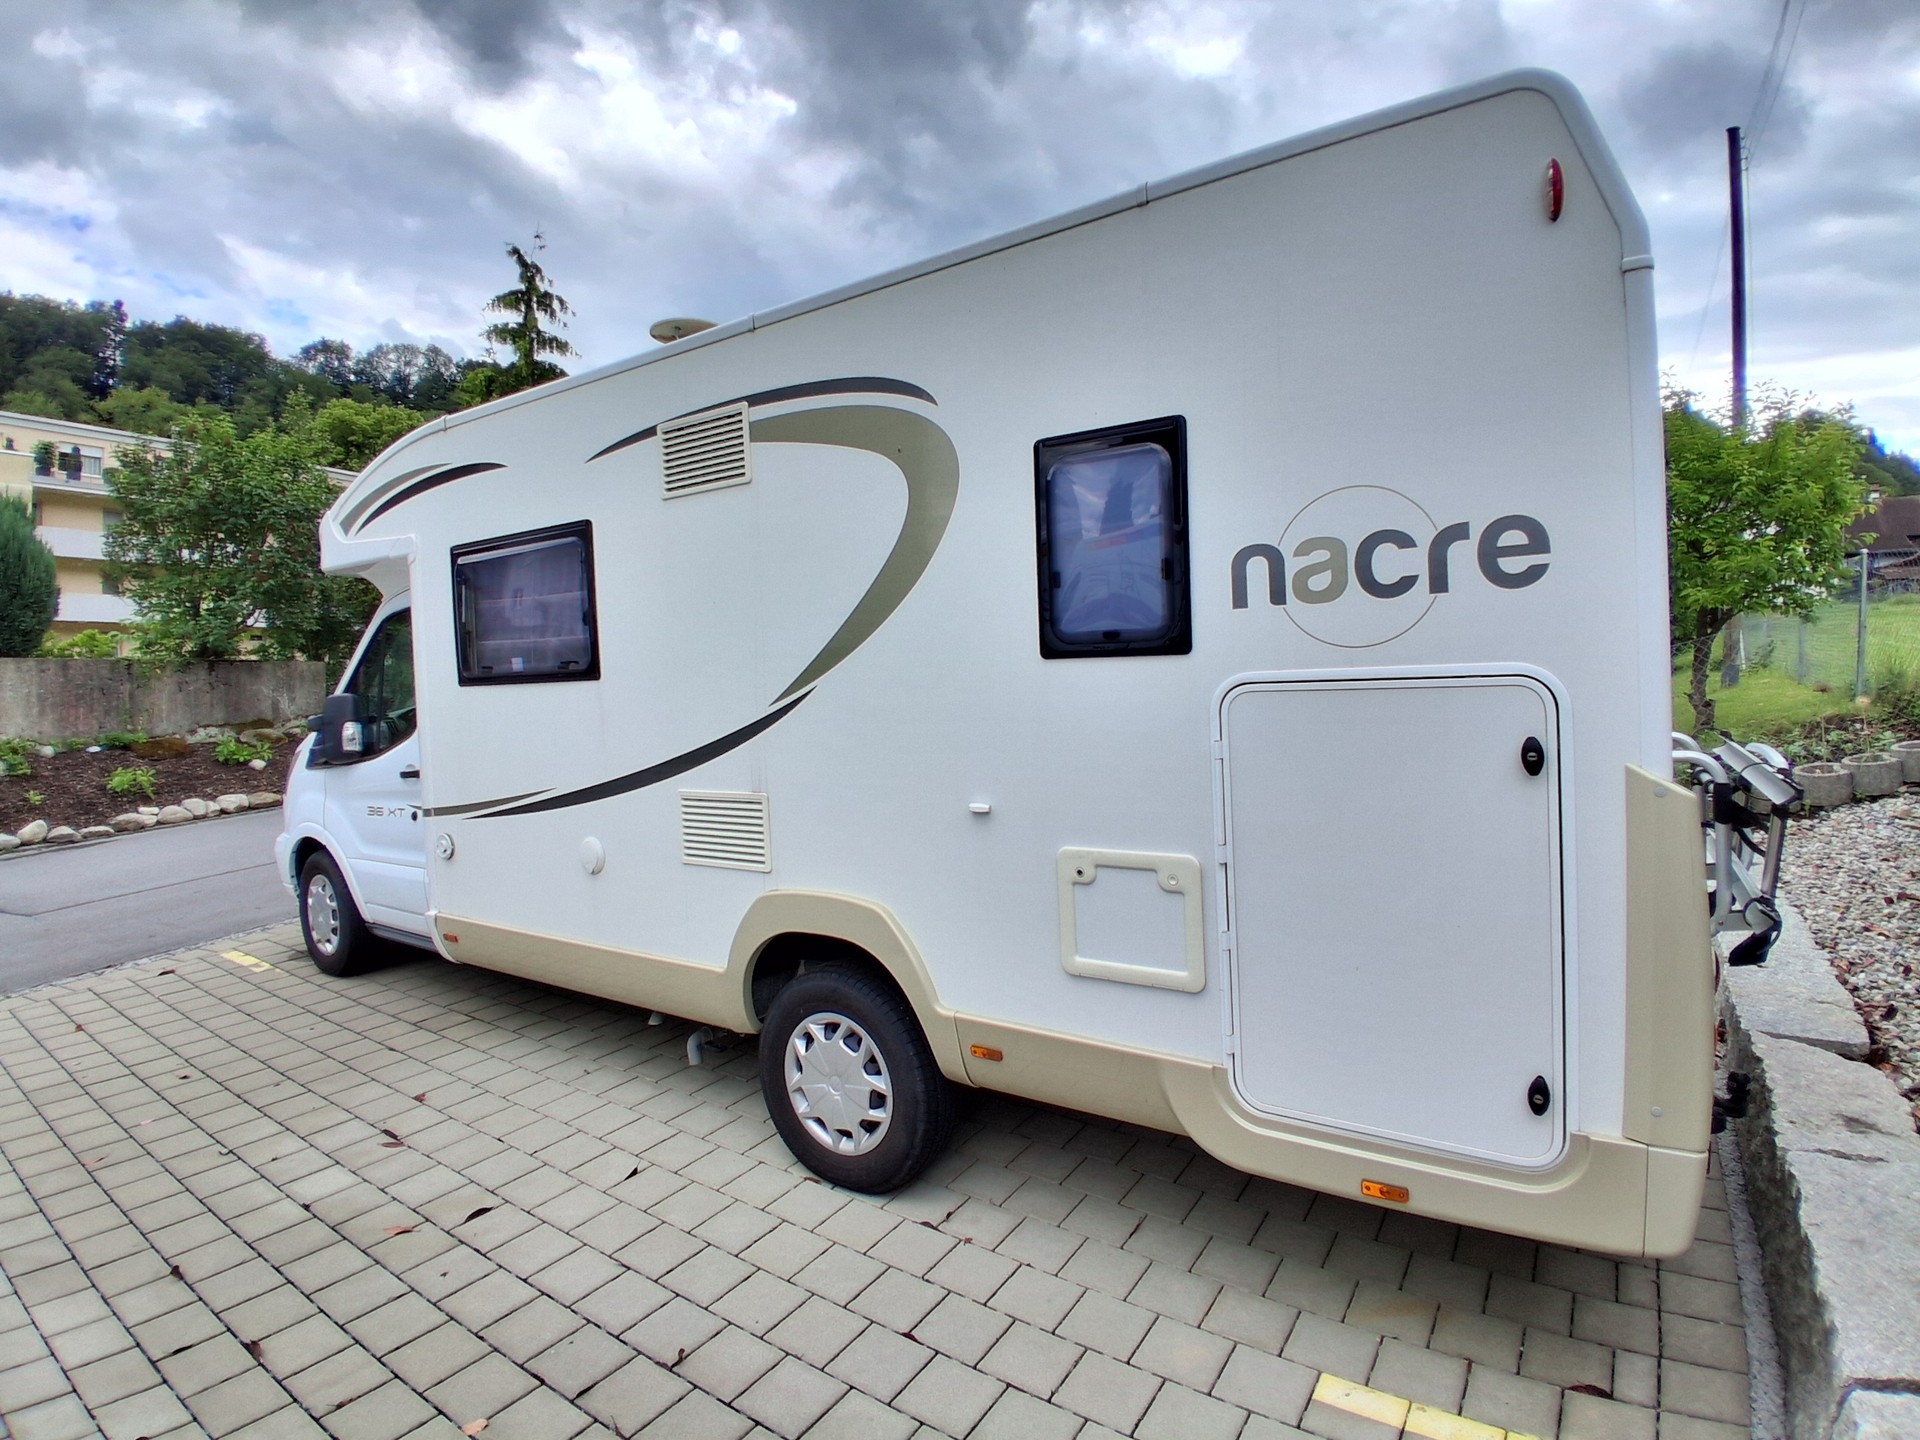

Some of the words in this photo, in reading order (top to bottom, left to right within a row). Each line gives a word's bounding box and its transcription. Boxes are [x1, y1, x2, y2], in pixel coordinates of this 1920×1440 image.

[1231, 514, 1551, 610] nacre
[367, 805, 384, 817] 36
[387, 807, 406, 818] XT
